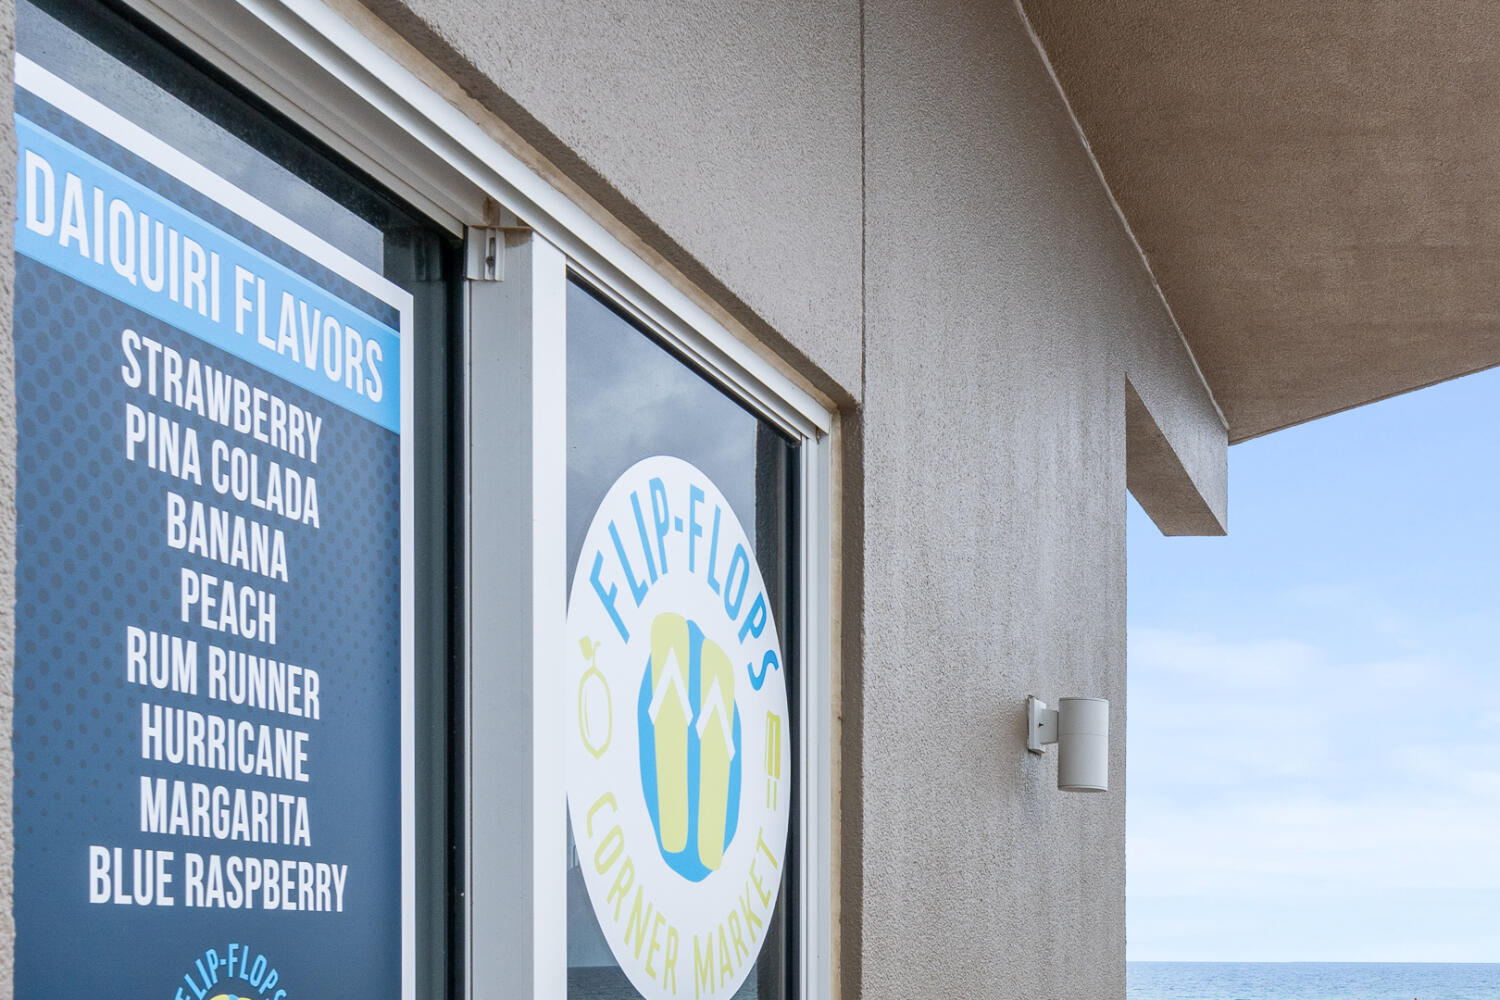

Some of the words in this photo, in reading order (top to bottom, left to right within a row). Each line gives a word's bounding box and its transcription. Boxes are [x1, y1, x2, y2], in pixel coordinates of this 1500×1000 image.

[25, 149, 221, 324] DAIQUIRI
[235, 264, 384, 403] FLAVORS
[120, 328, 323, 464] STRAWBERRY
[125, 403, 203, 486] PINA
[211, 439, 321, 530] COLADA
[166, 491, 289, 583] BANANA
[589, 476, 780, 692] FLIP-FLOPS
[180, 567, 277, 645] PEACH
[126, 625, 198, 696] RUM
[208, 645, 321, 721] RUNNER
[141, 702, 310, 783] HURRICANE
[140, 776, 312, 848] MARGARITA
[89, 845, 175, 907] BLUE
[184, 852, 348, 913] RASPBERRY
[585, 791, 680, 995] CORNER
[693, 826, 780, 1000] MARKET
